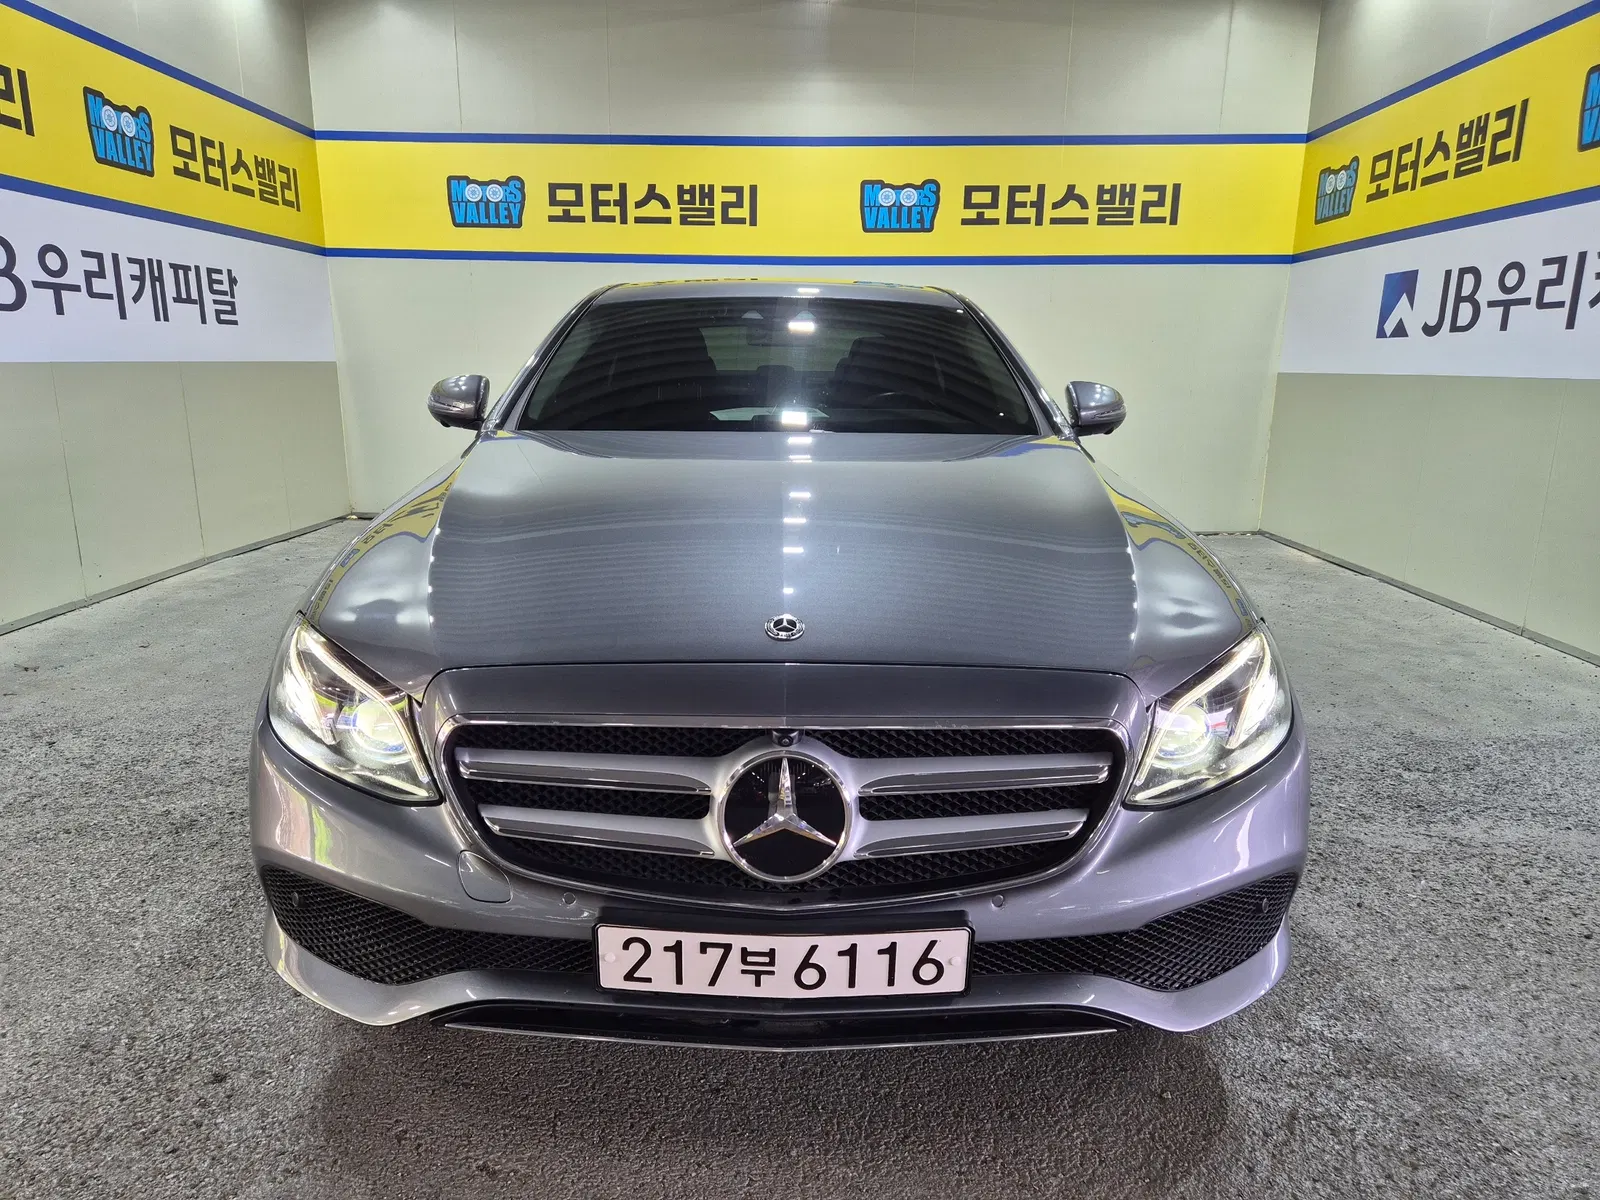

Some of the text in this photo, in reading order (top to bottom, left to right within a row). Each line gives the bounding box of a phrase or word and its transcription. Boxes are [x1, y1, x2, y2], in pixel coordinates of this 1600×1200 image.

[91, 125, 152, 172] VALLEY
[169, 125, 301, 212] 모터스밸리
[1366, 98, 1530, 203] 모터스밸리
[452, 202, 521, 224] VALLEY
[547, 183, 758, 226] 모터스밸리
[864, 206, 935, 229] VALLEY
[961, 183, 1182, 226] 모터스밸리
[1421, 250, 1600, 337] JB우리
